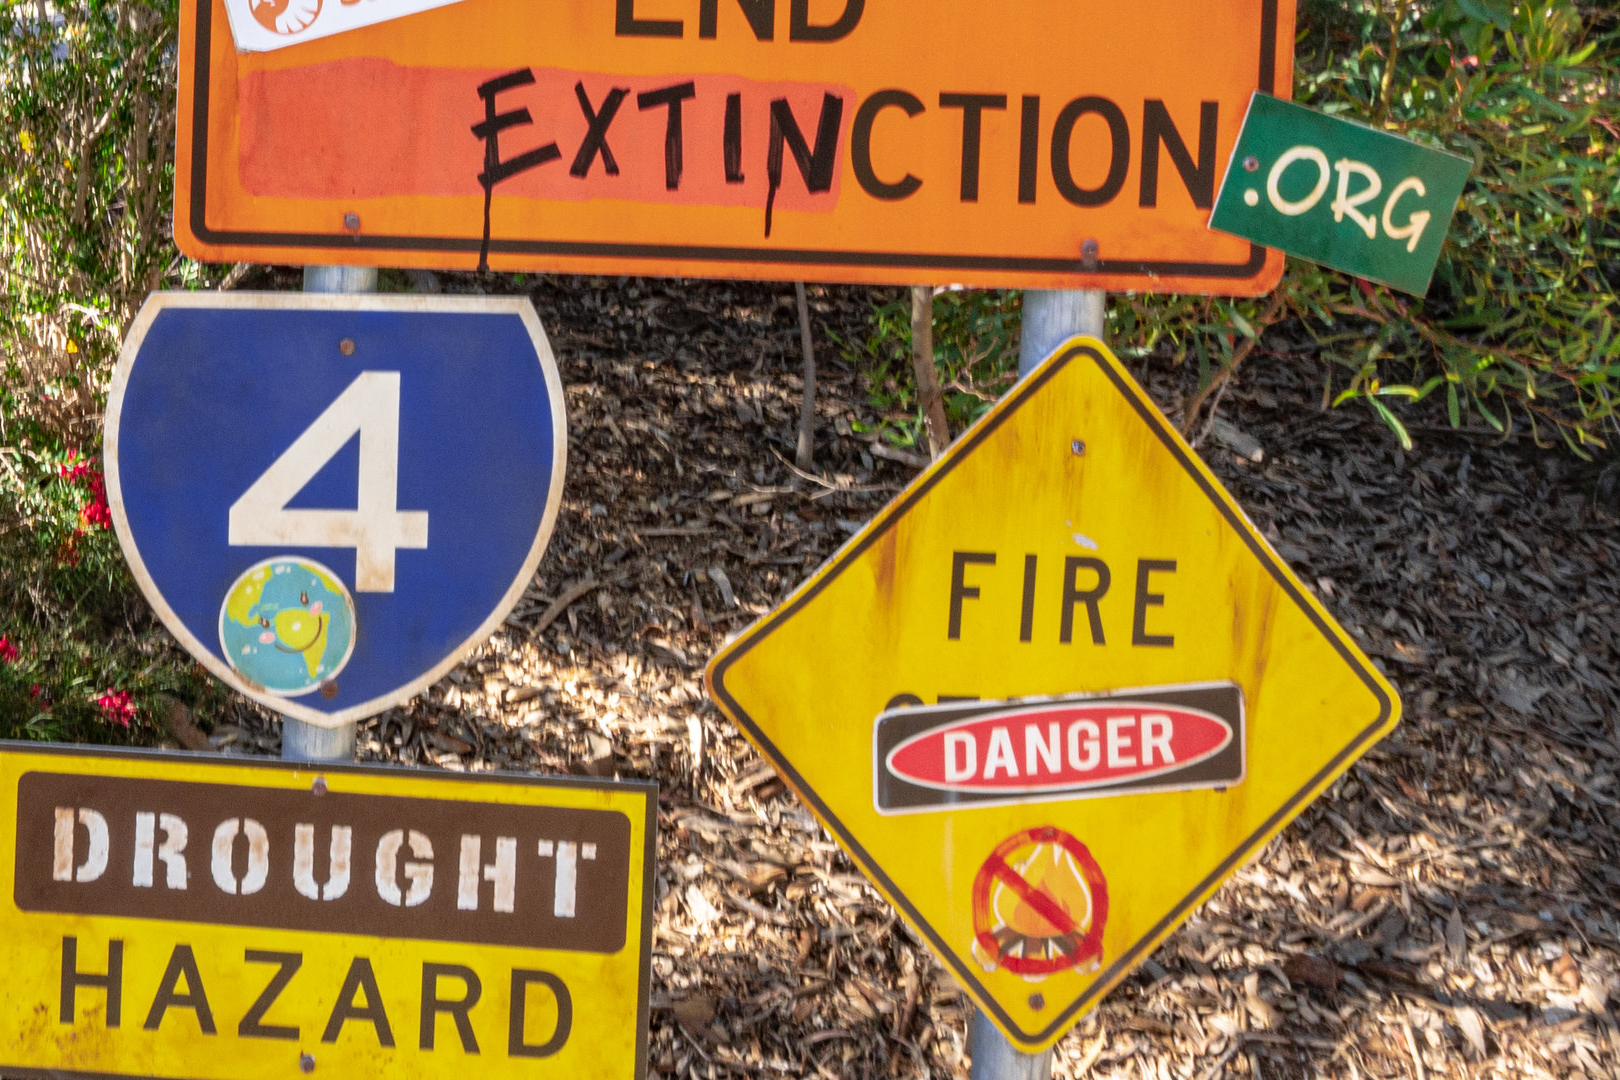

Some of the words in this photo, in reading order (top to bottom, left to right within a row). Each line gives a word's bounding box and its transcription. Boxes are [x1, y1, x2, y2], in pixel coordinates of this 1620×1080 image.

[471, 67, 1218, 212] EXTINCTION
[1244, 145, 1431, 252] .ORG
[228, 370, 429, 592] 4
[947, 551, 1177, 648] FIRE
[943, 714, 1176, 783] DANGER
[52, 807, 597, 918] DROUGHT
[58, 935, 573, 1060] HAZARD
